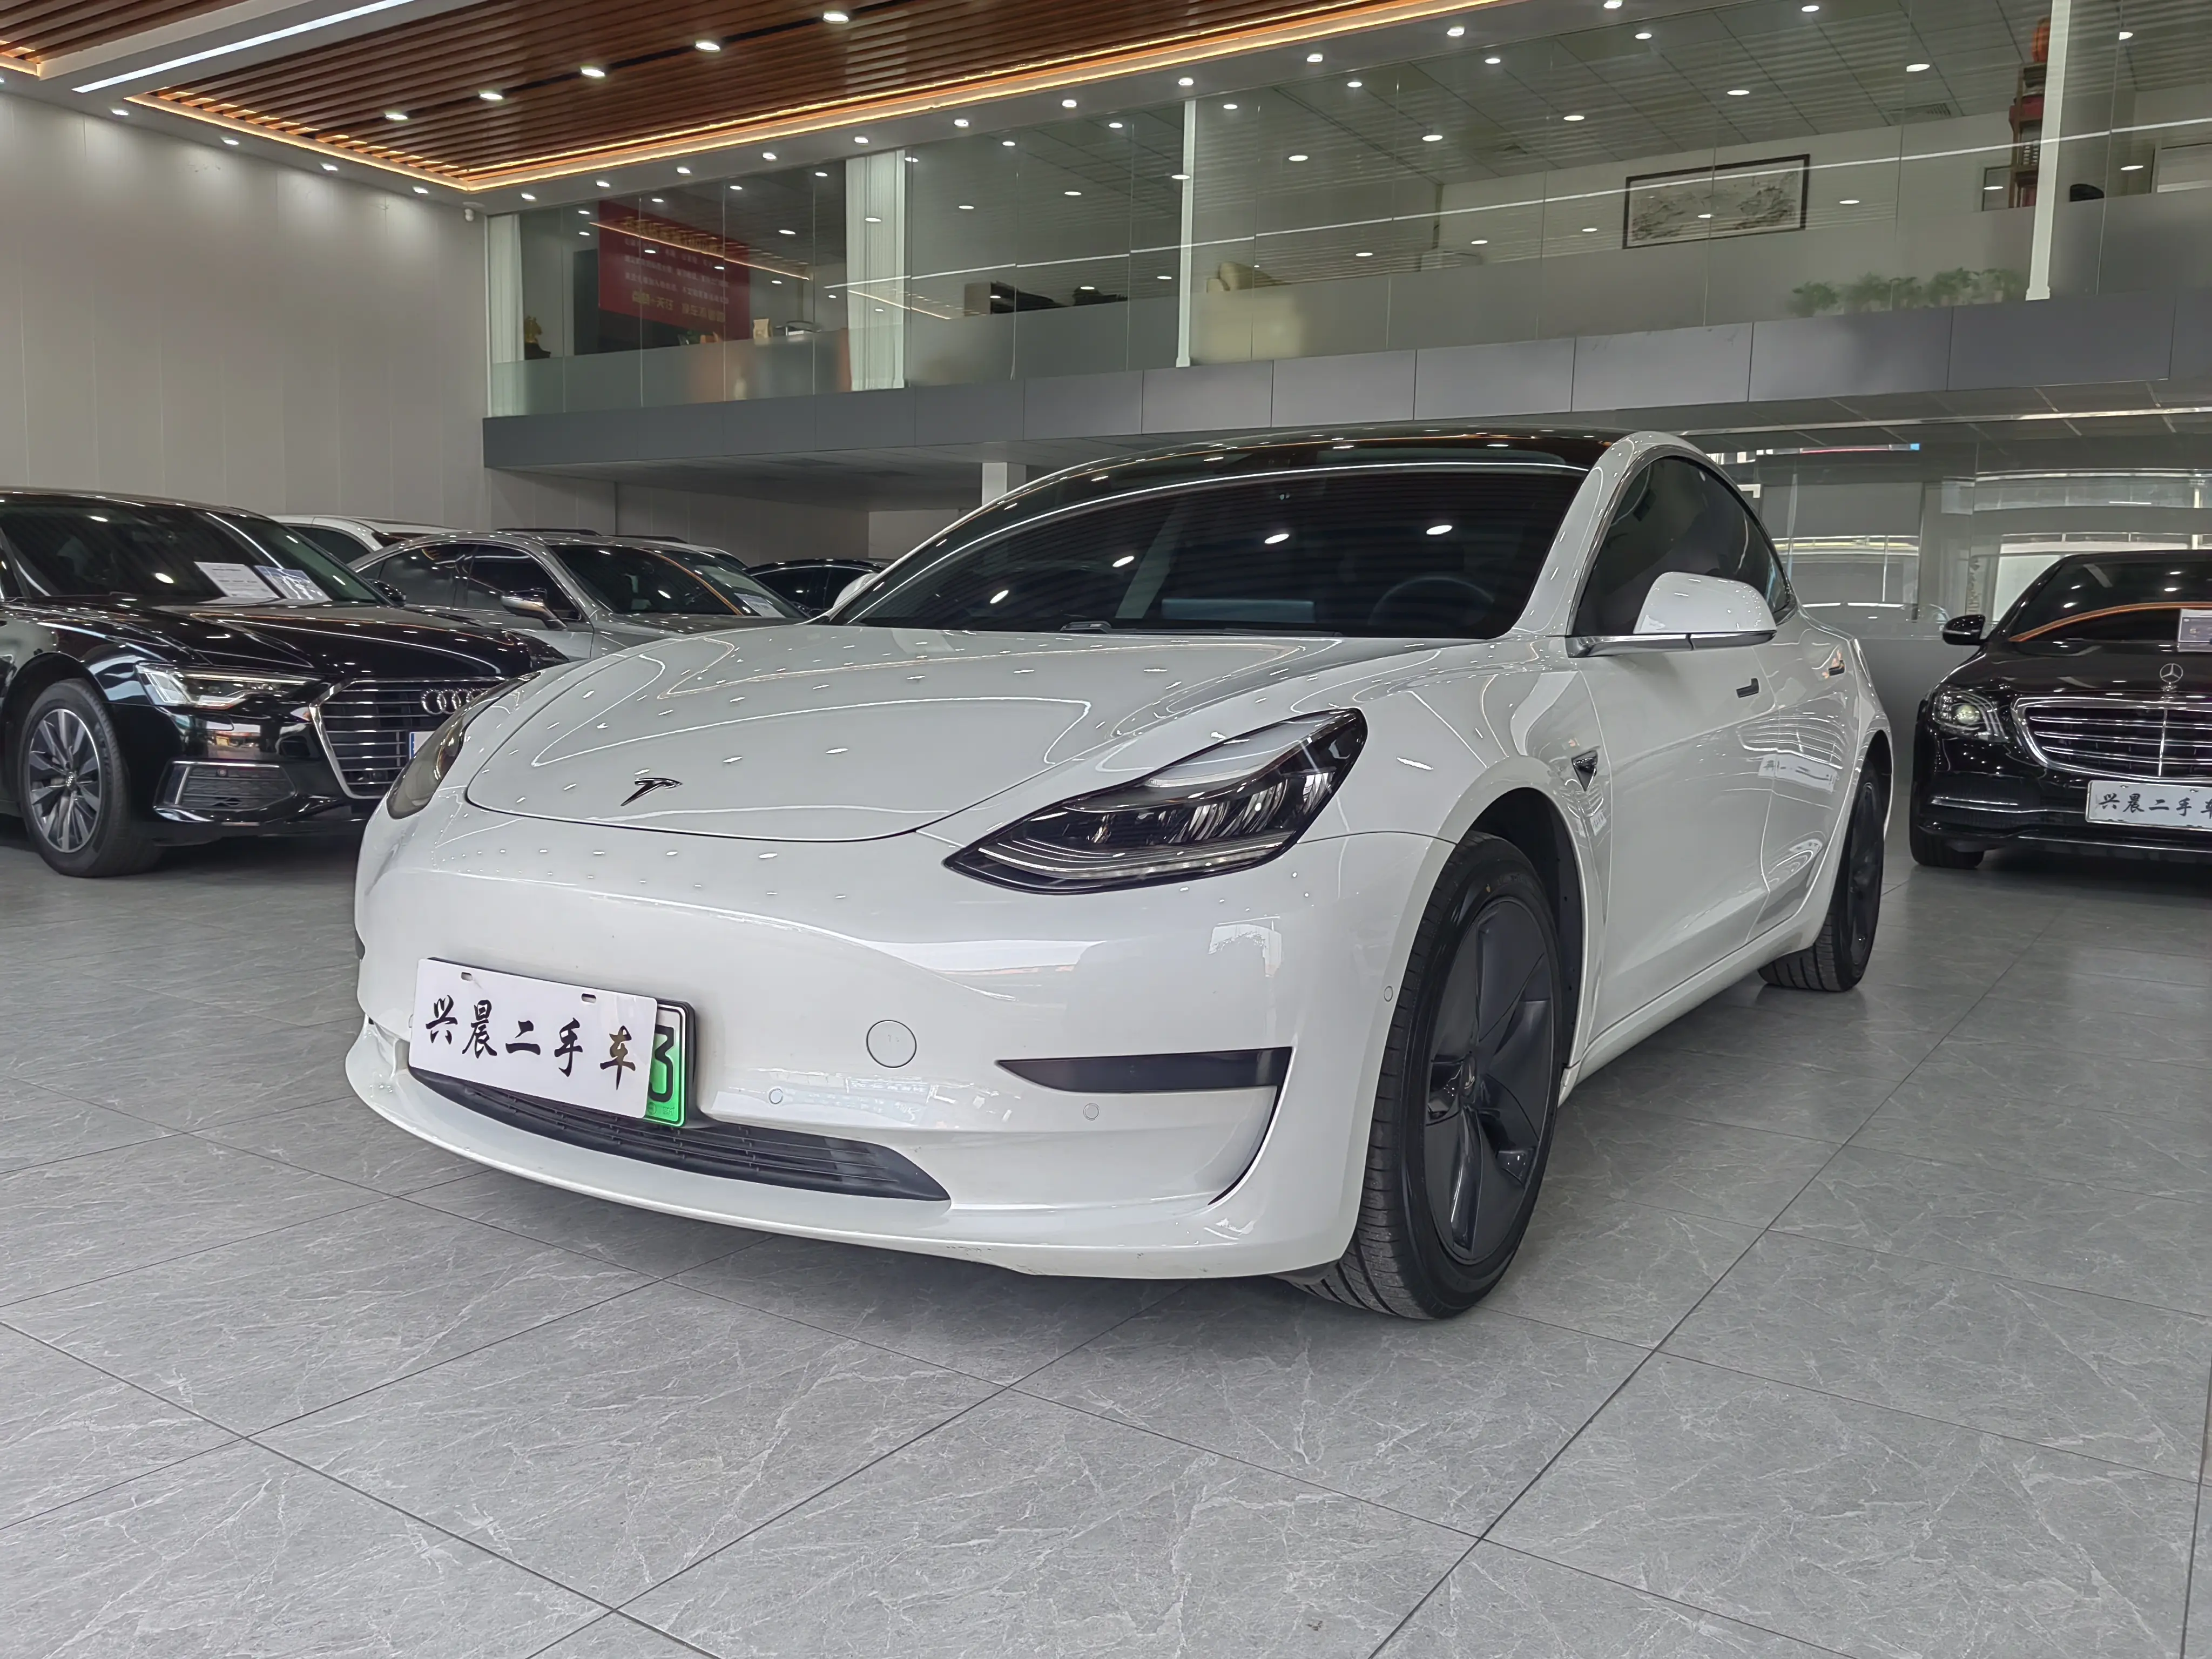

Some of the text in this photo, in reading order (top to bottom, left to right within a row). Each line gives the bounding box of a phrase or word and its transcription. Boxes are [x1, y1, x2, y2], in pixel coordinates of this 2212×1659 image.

[425, 994, 636, 1090] 兴晨二手车
